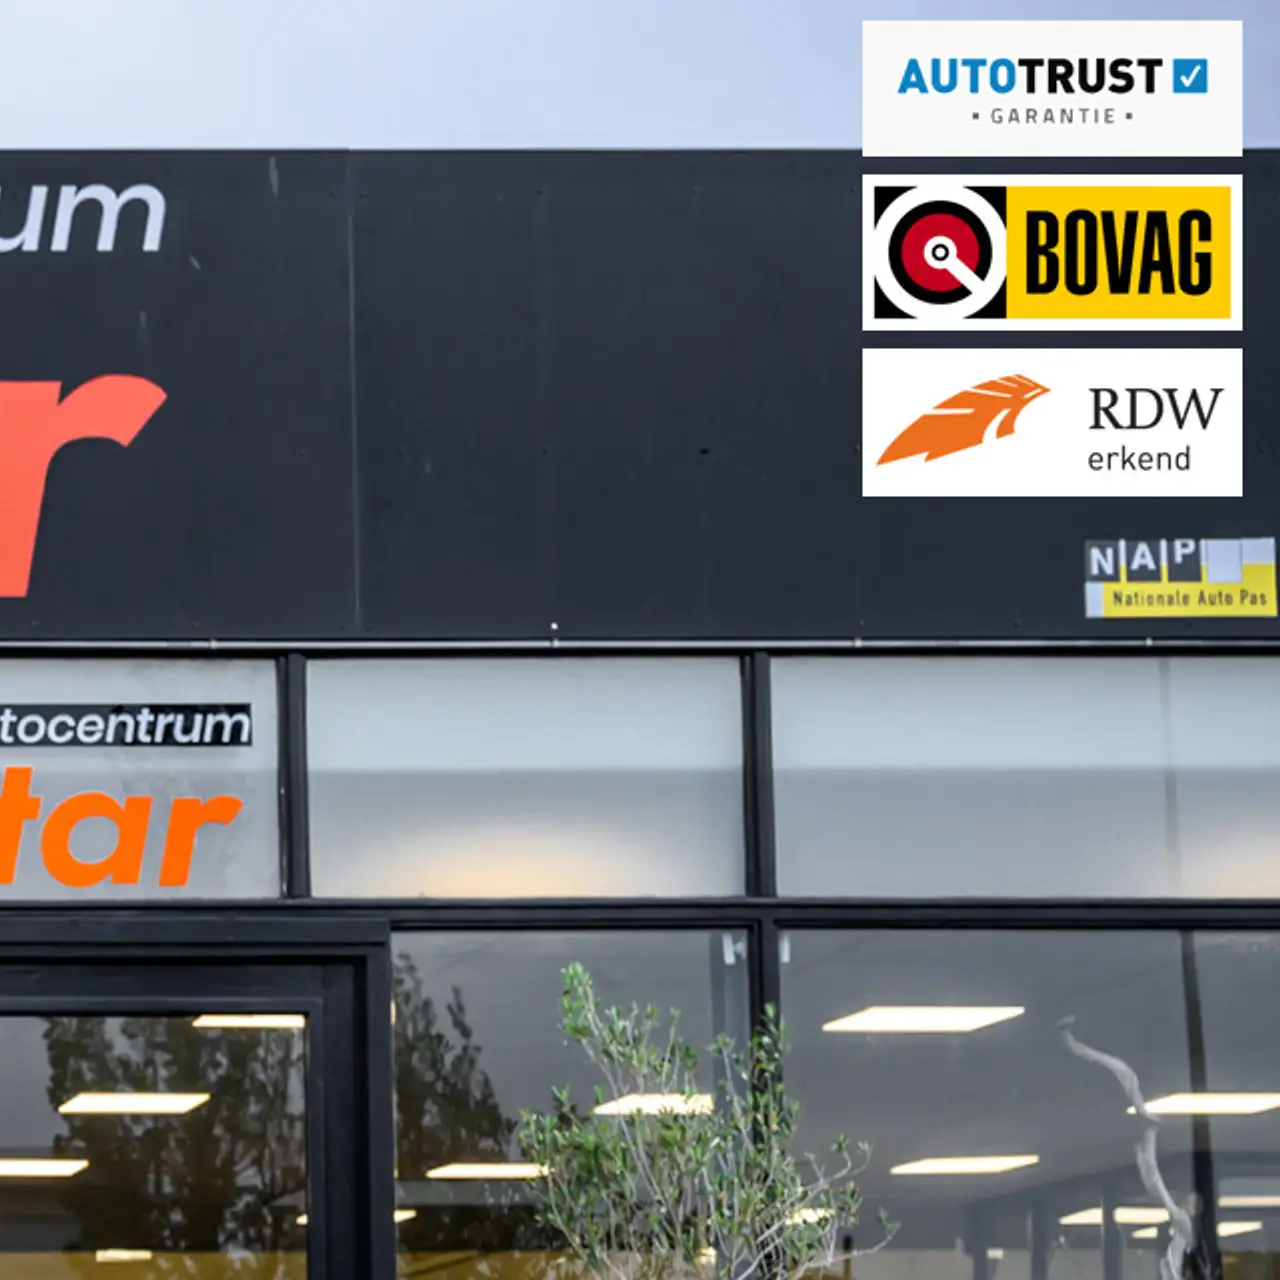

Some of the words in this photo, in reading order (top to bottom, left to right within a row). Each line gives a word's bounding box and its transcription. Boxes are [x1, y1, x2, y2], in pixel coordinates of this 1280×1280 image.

[1113, 589, 1190, 607] Nationale
[1198, 589, 1234, 606] Auto
[1239, 588, 1268, 606] Pas
